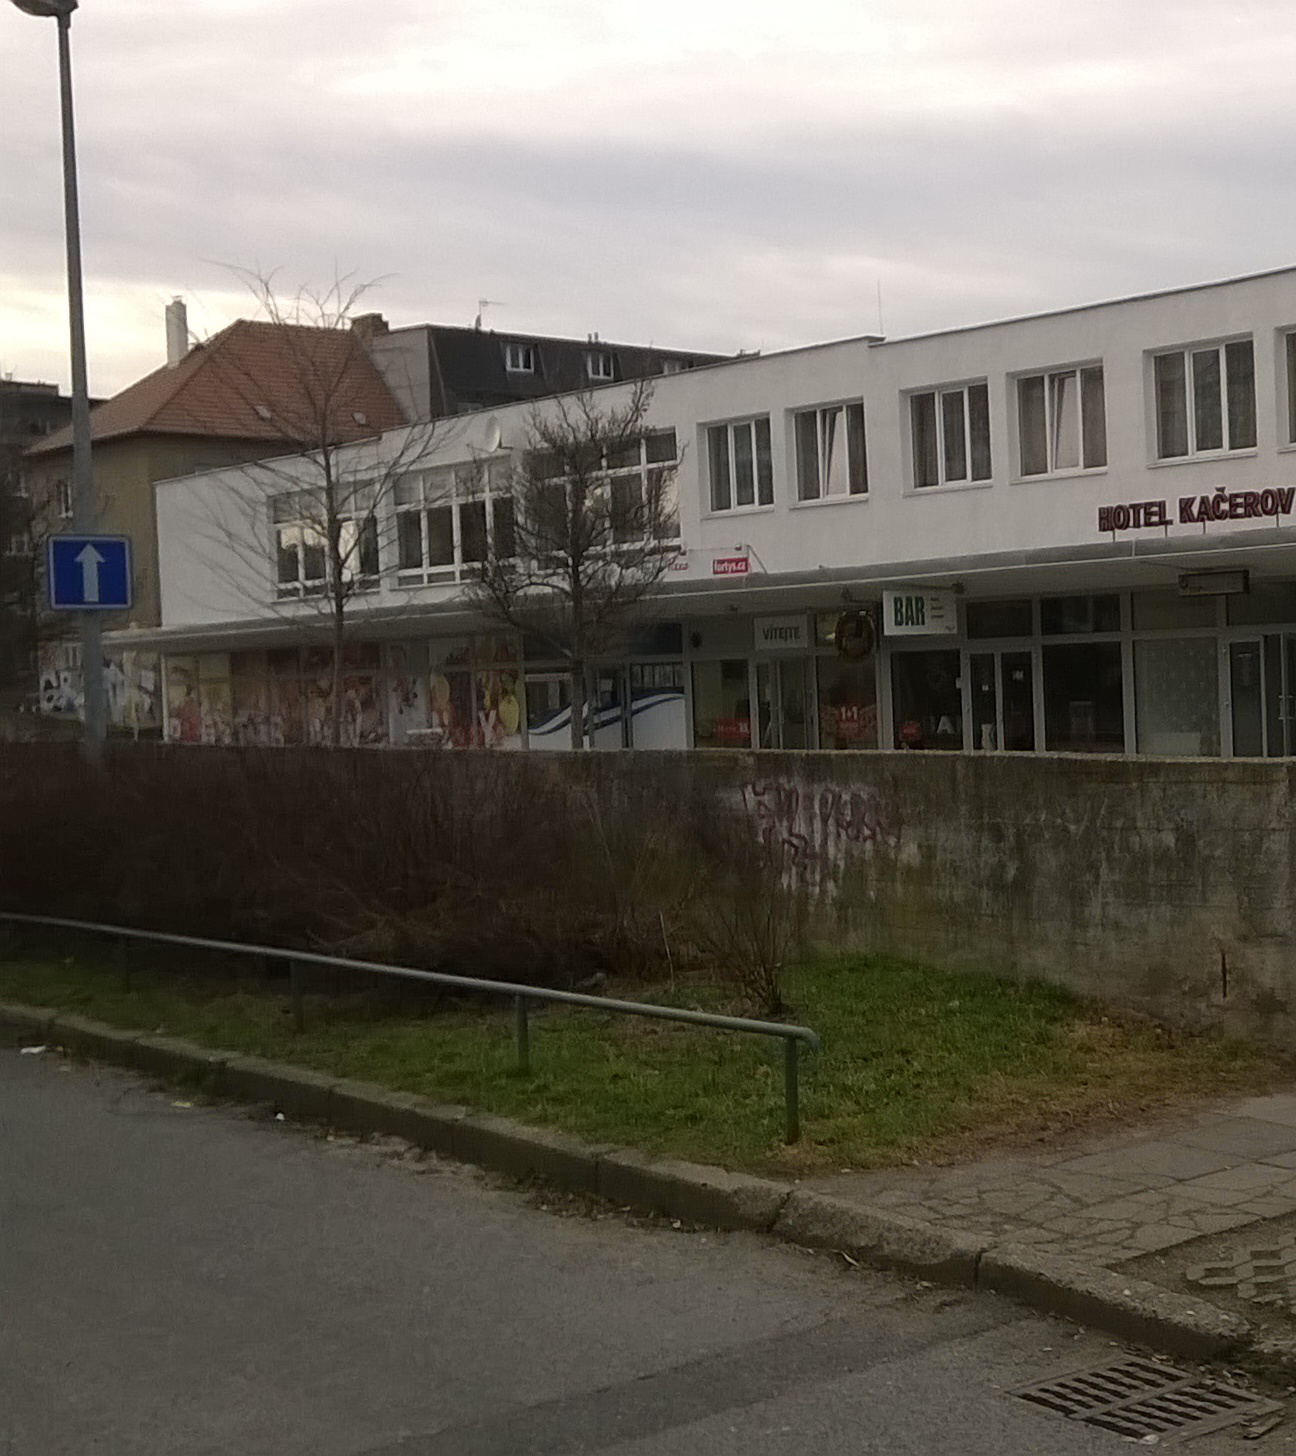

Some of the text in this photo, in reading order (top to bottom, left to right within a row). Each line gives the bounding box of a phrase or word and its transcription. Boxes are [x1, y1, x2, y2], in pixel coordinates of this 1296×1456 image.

[1098, 486, 1296, 532] HOTEL KAČEROV
[893, 596, 926, 626] BAR
